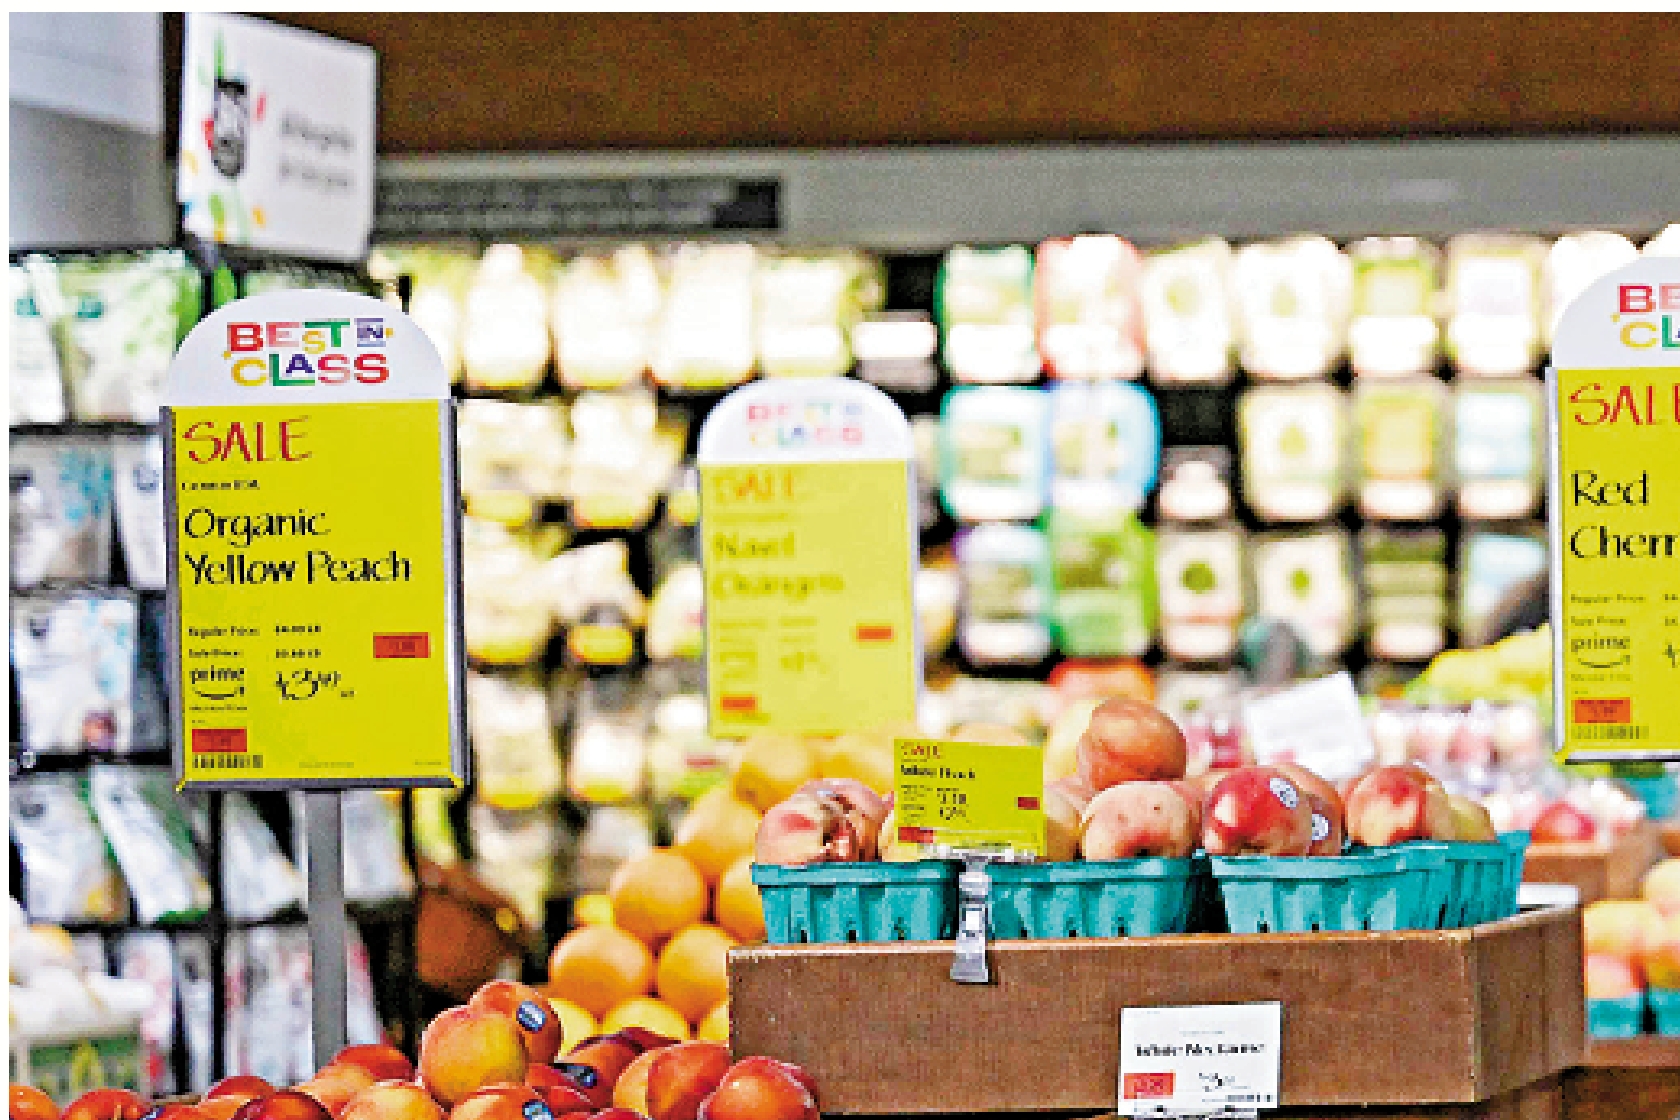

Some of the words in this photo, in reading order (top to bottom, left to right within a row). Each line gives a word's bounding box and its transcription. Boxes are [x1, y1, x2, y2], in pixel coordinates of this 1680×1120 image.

[227, 317, 350, 355] BEST
[356, 319, 386, 346] IN
[231, 353, 389, 386] CLASS
[182, 416, 313, 464] SALE
[1570, 470, 1650, 507] Red
[184, 508, 331, 548] Organic
[184, 550, 296, 585] Yellow
[306, 549, 411, 585] Peach
[1570, 631, 1632, 653] prime
[189, 663, 245, 686] prime
